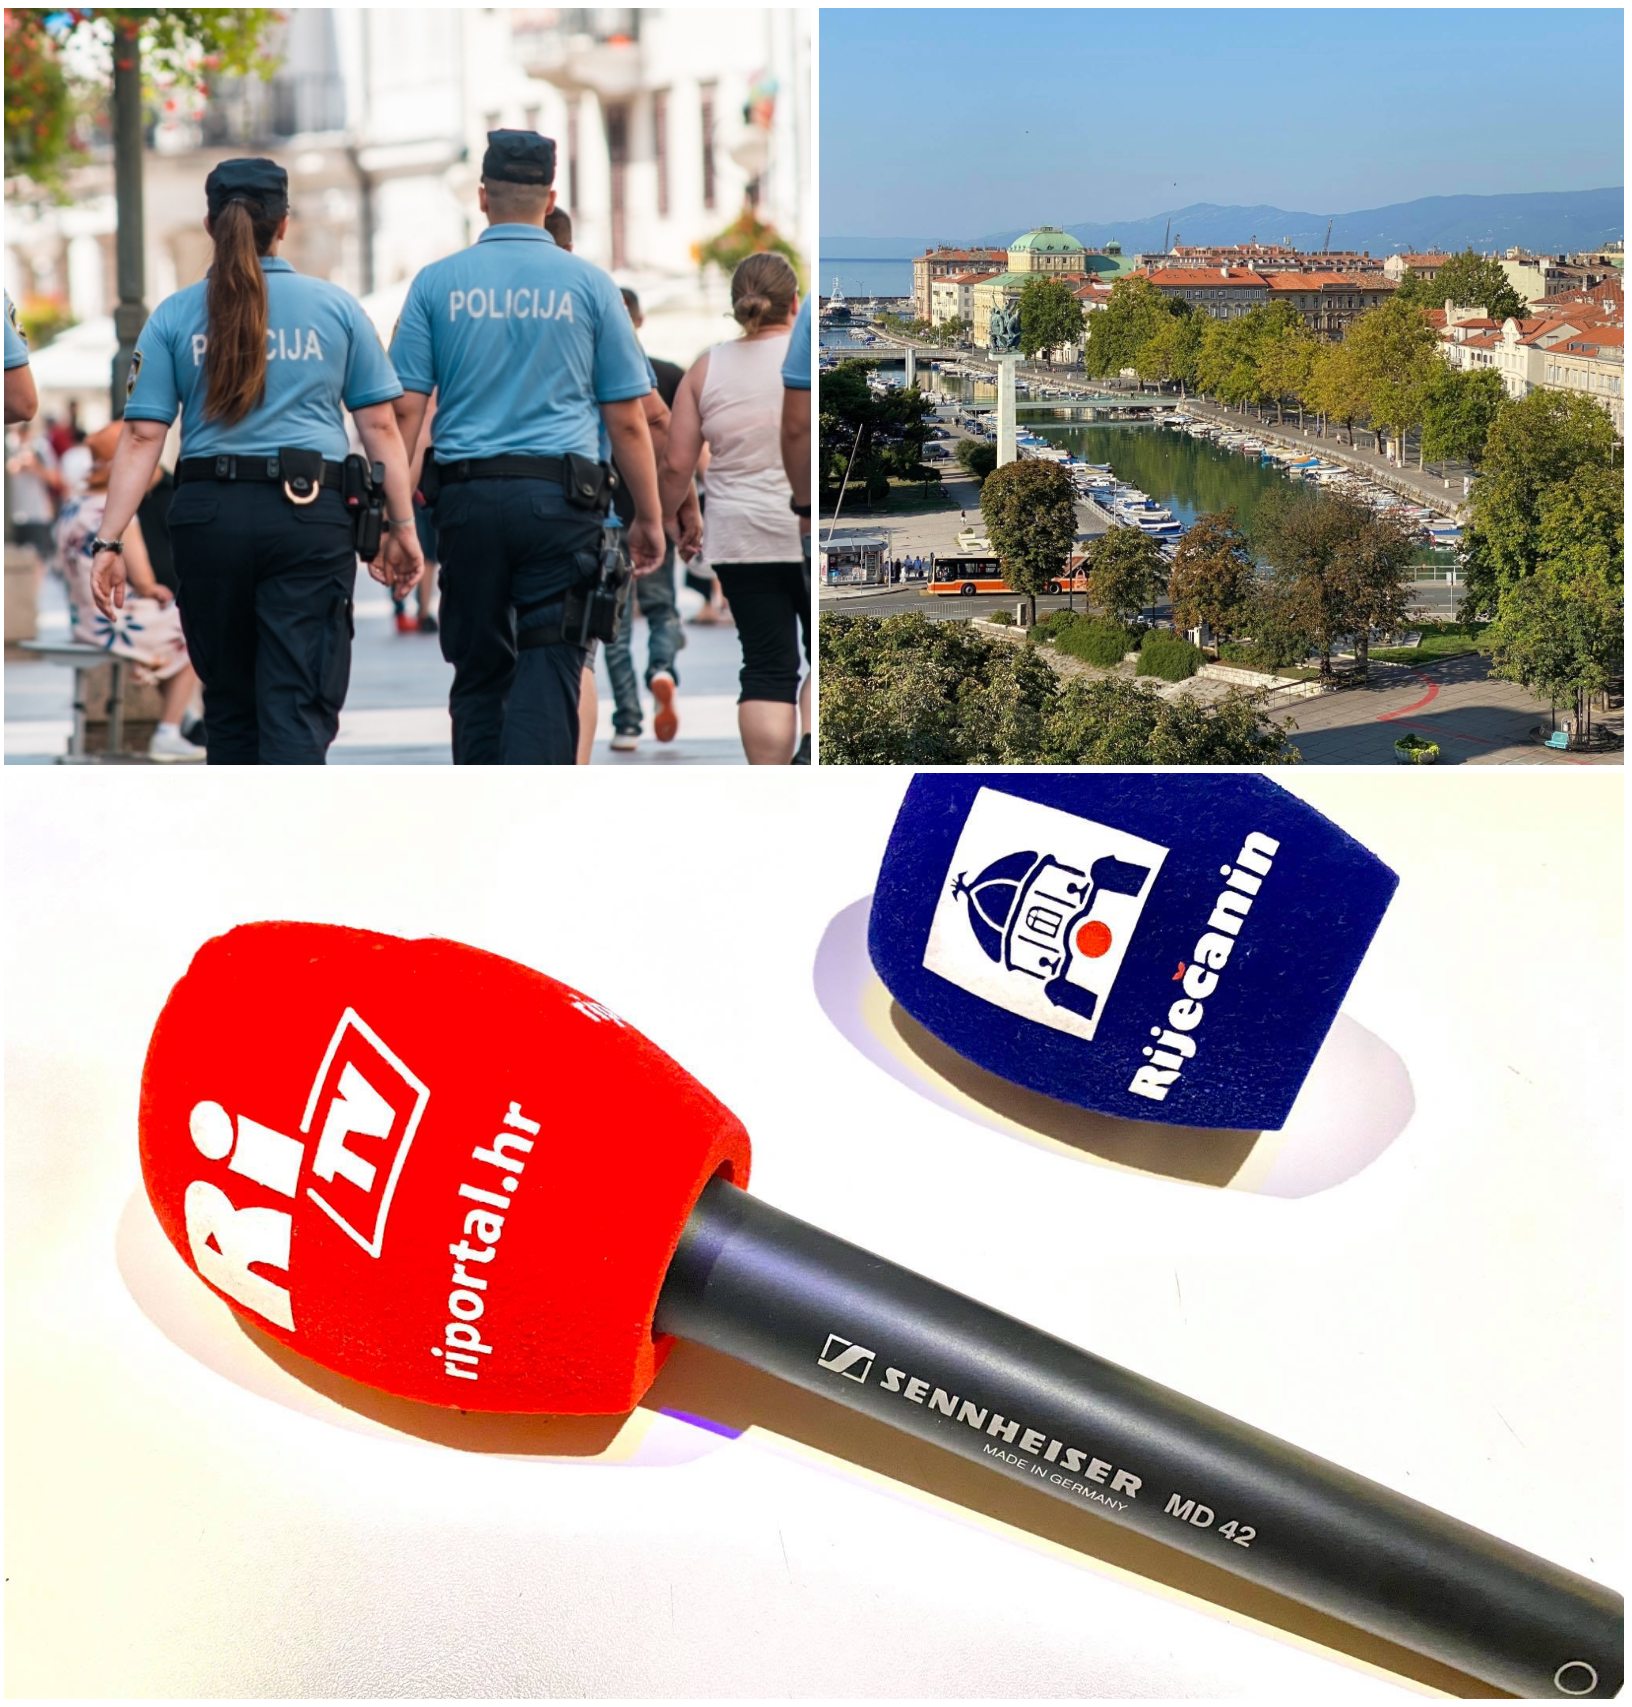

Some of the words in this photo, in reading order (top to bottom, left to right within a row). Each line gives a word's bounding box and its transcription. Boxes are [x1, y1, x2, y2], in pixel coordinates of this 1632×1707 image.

[191, 327, 324, 367] PCIJA
[449, 287, 574, 324] POLICIJA
[1129, 831, 1280, 1101] Riječanin
[184, 1100, 305, 1331] Ri
[312, 1061, 396, 1193] TV
[430, 1101, 542, 1381] riportal.hr
[880, 1366, 1143, 1499] SENNHEISER
[982, 1443, 1027, 1471] MADE
[1030, 1463, 1048, 1479] IN
[1049, 1473, 1129, 1513] GERMANY
[1163, 1493, 1215, 1530] MD
[1218, 1519, 1258, 1549] 42
